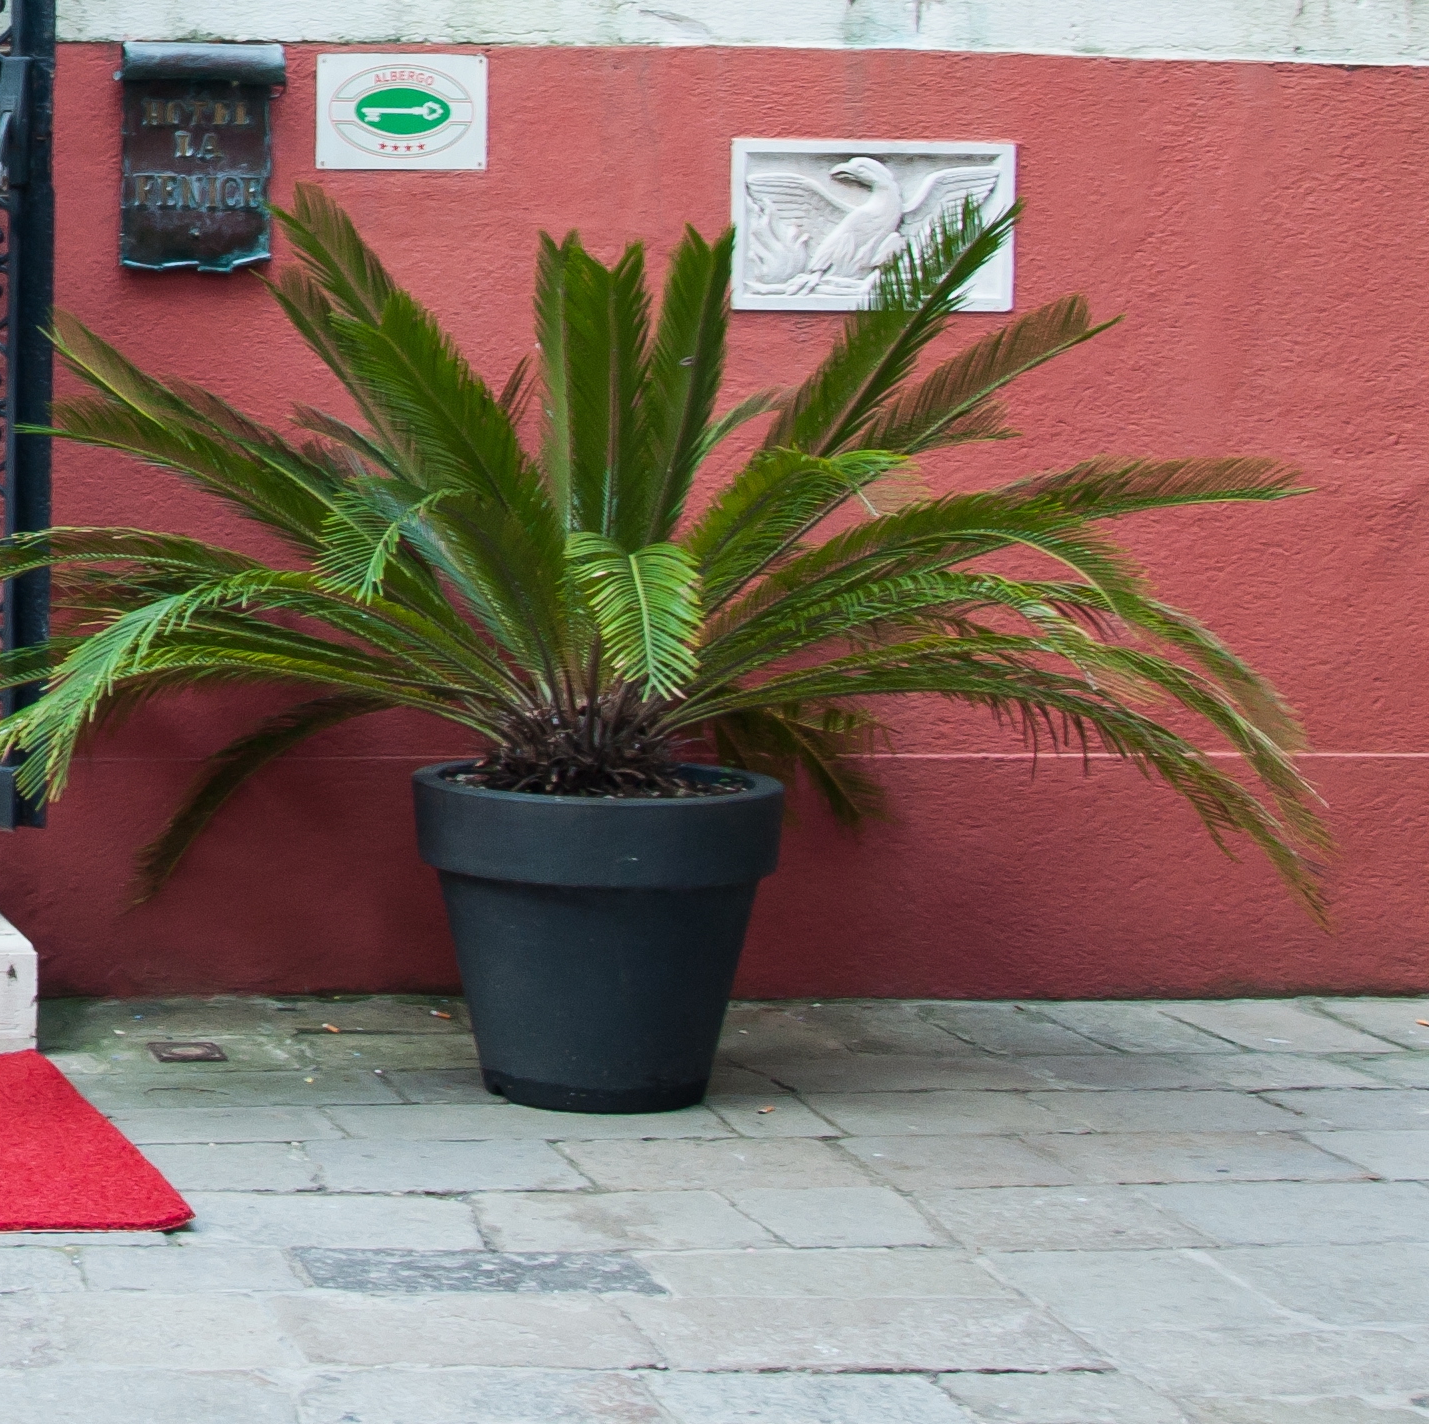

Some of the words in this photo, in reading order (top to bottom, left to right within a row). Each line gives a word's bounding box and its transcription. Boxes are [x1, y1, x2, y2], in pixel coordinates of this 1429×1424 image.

[373, 70, 435, 87] ALBERGO
[141, 99, 251, 127] HOTEL
[174, 130, 224, 159] LA
[134, 173, 262, 208] FENICE
